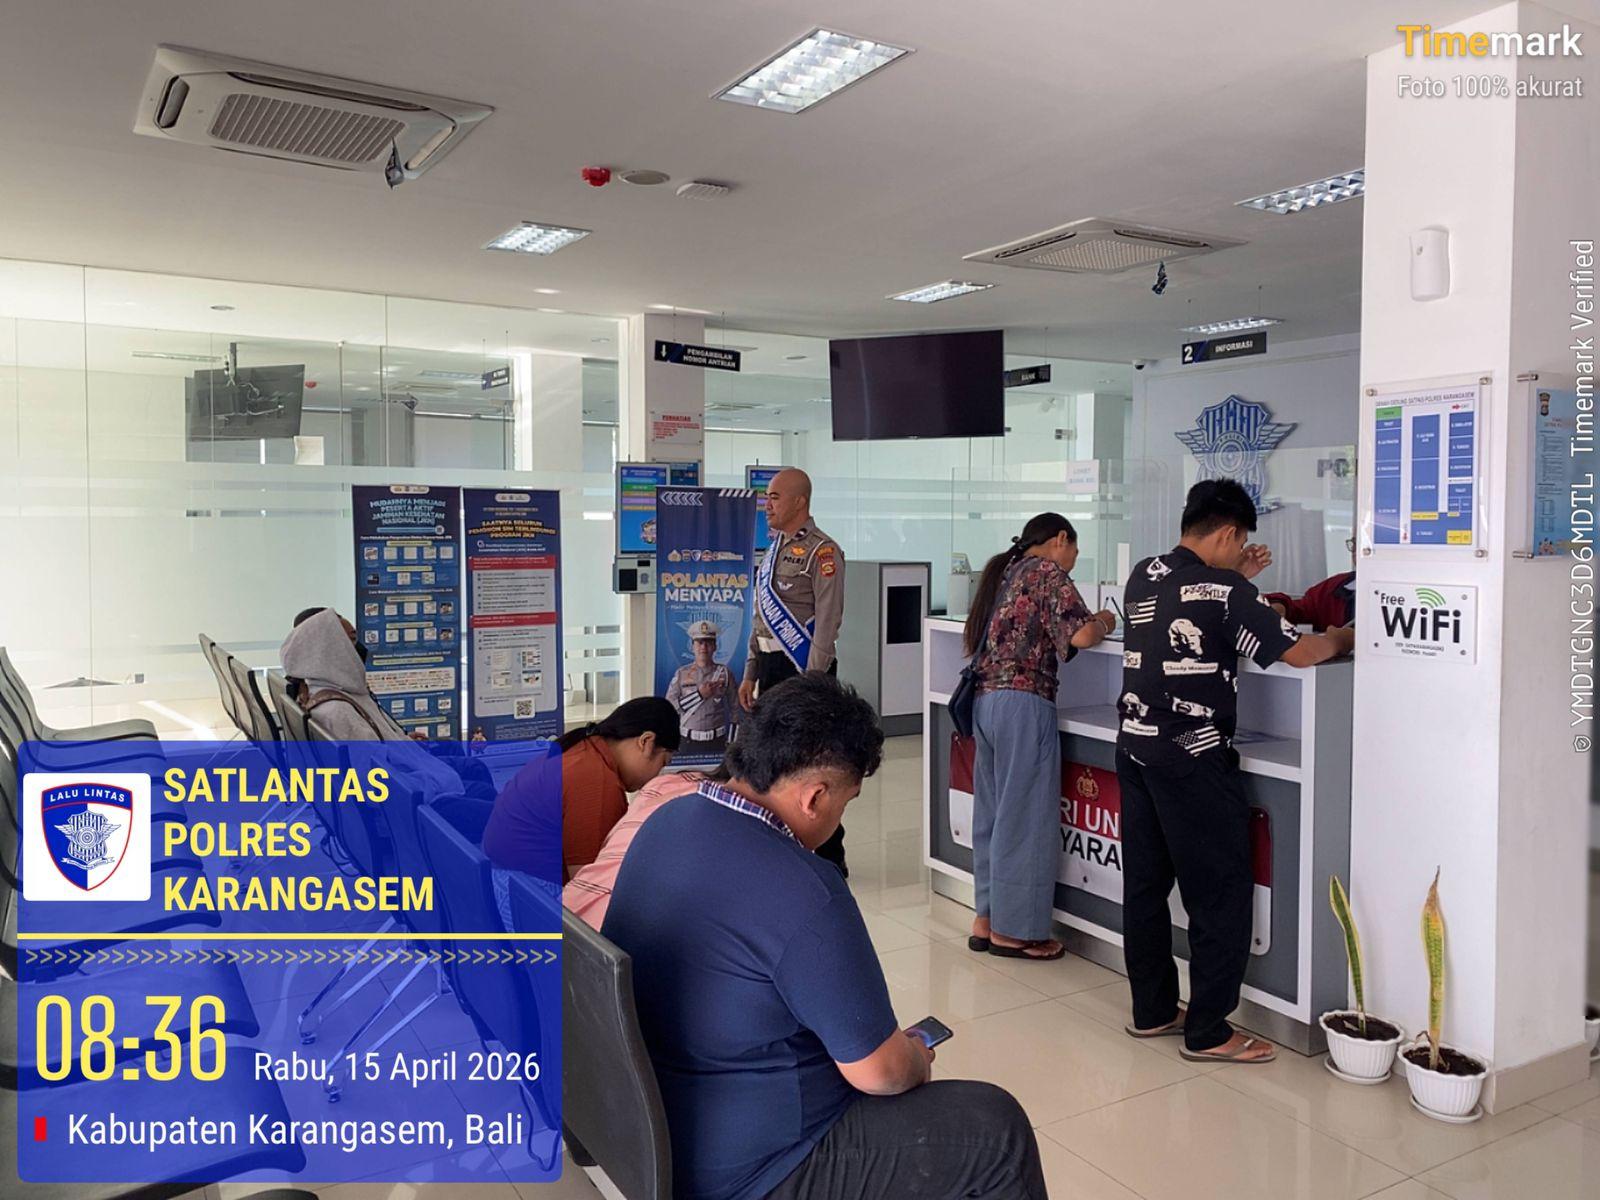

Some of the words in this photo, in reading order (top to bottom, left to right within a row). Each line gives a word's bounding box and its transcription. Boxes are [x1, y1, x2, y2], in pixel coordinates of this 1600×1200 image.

[687, 348, 733, 360] PENGAMBILAN
[1184, 345, 1193, 362] 2
[1215, 340, 1253, 353] INFORMASI
[683, 355, 707, 364] NOMOR
[708, 358, 736, 368] ANTRIAN
[783, 556, 805, 565] POLRI
[661, 572, 749, 588] POLANTAS
[665, 588, 744, 602] MENYAPA
[1381, 606, 1461, 643] WiFi
[774, 617, 805, 651] PRIMA
